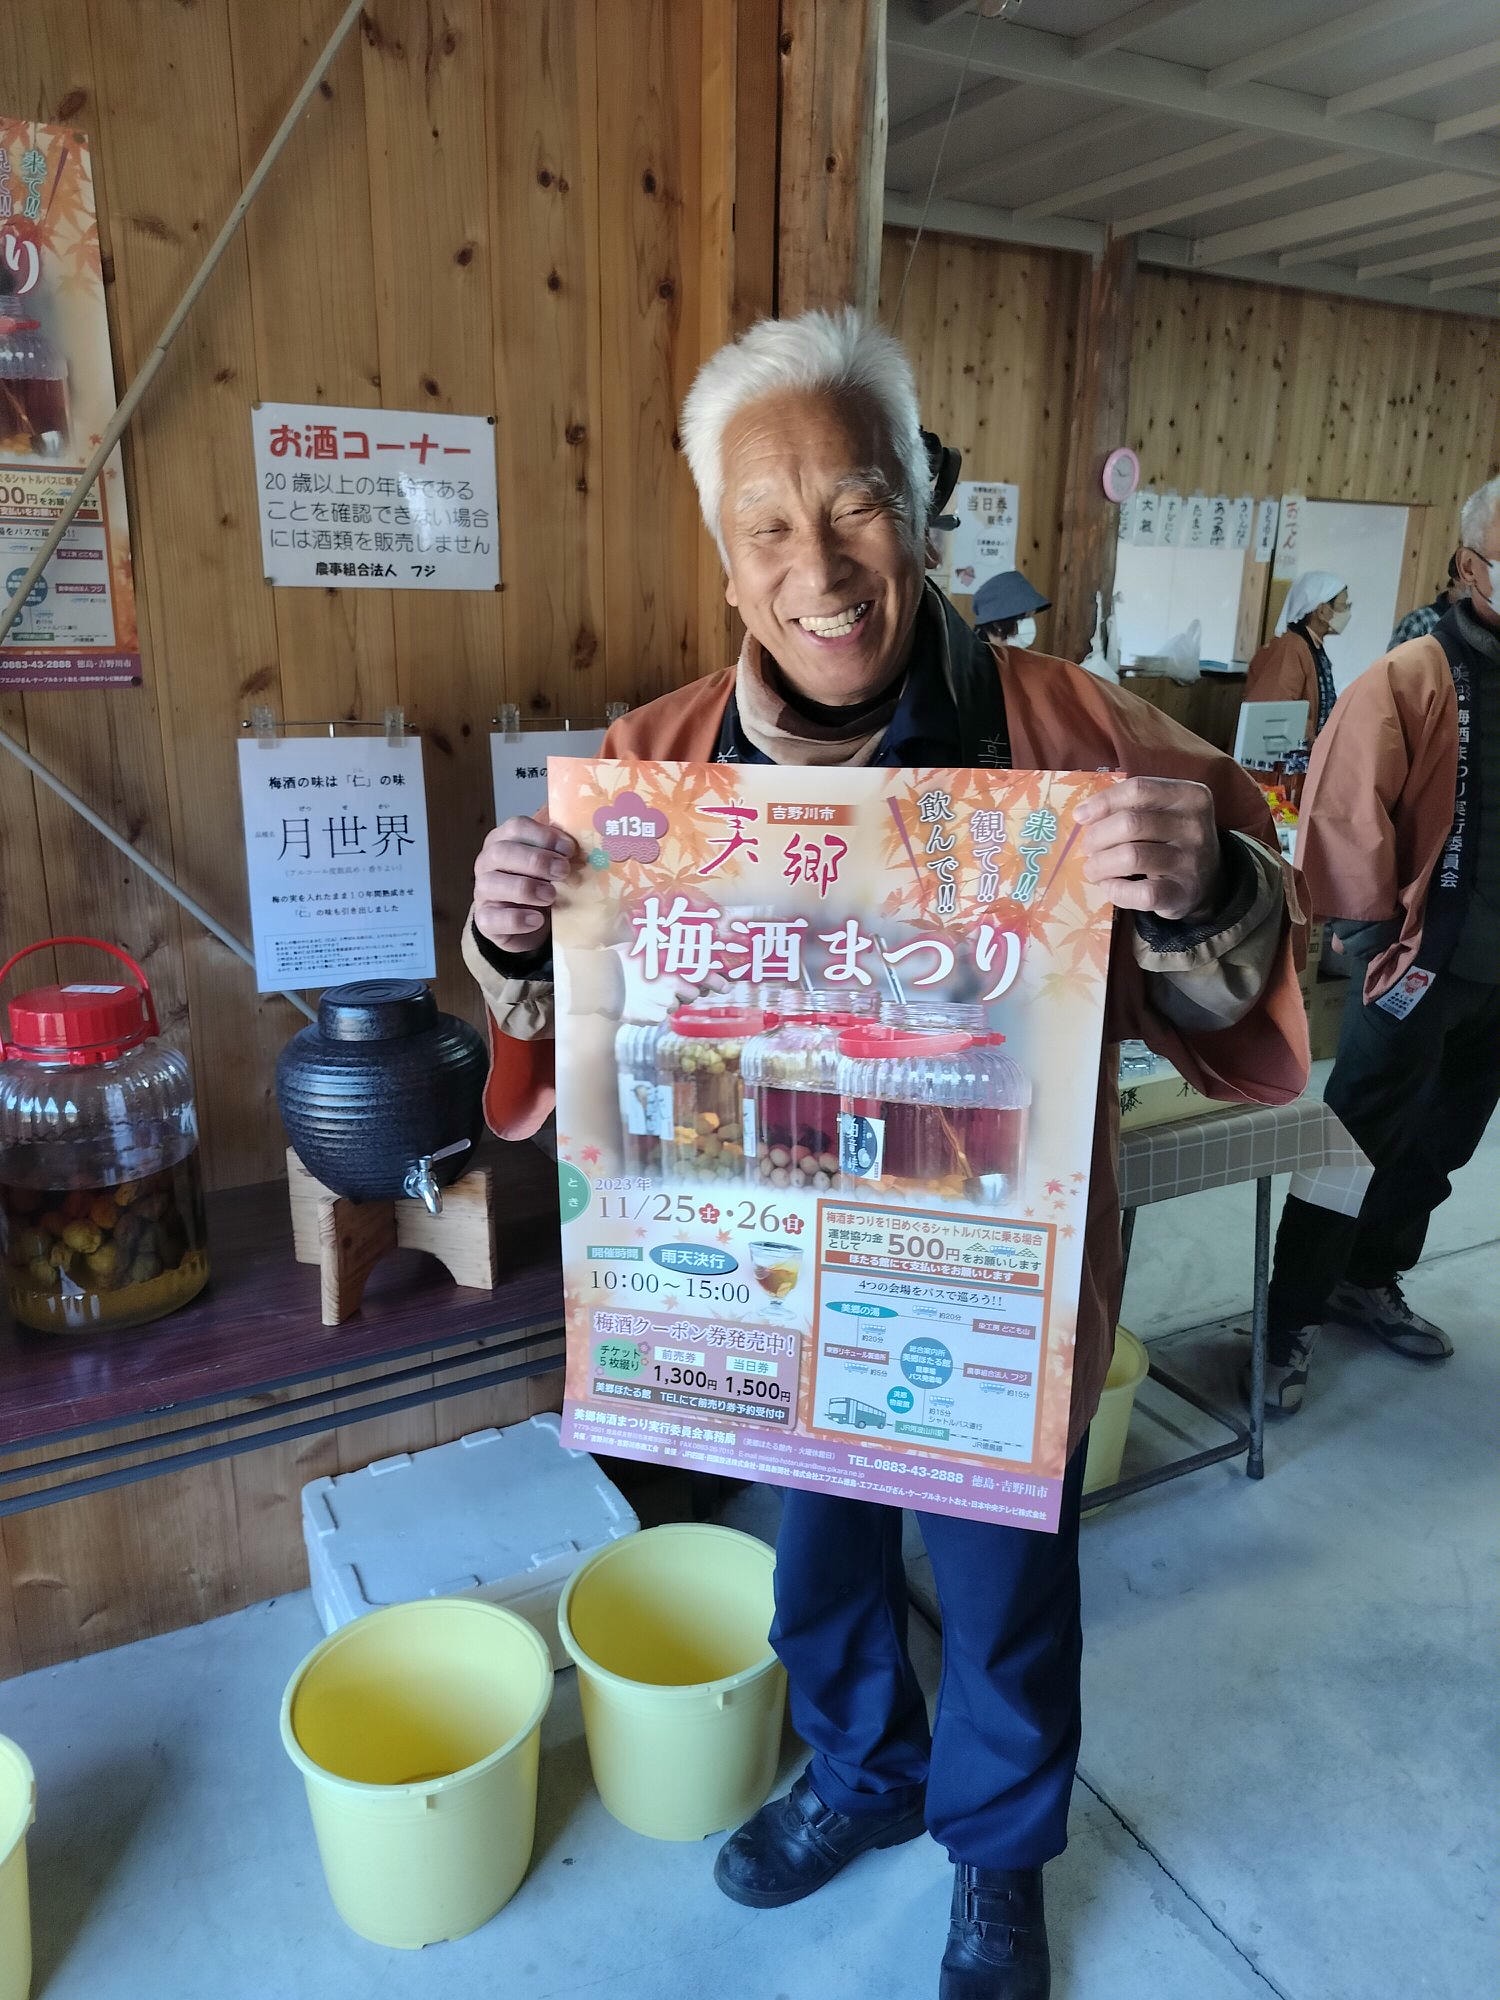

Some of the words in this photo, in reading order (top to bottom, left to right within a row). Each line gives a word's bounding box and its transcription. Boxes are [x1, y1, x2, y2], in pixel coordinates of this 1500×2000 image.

[269, 424, 471, 465] お酒コーナー
[267, 502, 489, 528] ことを確認できない場合
[270, 529, 490, 554] には酒類を販売しません
[315, 562, 397, 577] 農事組合法人
[411, 564, 436, 577] フジ
[269, 773, 406, 789] 梅酒の味は「仁」の味
[772, 806, 836, 820] 吉野川市
[277, 814, 416, 861] 月世界
[605, 815, 656, 837] 第13回
[630, 896, 1022, 1001] 梅酒まつり
[826, 1211, 1043, 1246] 梅酒まつりを1日めぐるシャトルバスに乗る場合
[828, 1228, 883, 1244] 運営協力金
[828, 1239, 861, 1251] として
[591, 1248, 639, 1259] 開催時間
[661, 1249, 726, 1270] 雨天決行
[849, 1253, 1014, 1282] ほたる館にて支払いをお願いします
[962, 1253, 1041, 1271] をお願いします
[601, 1345, 641, 1358] チケット
[662, 1349, 697, 1364] 前売券
[733, 1359, 769, 1374] 当日券
[654, 1365, 718, 1391] 1,300円
[725, 1376, 791, 1403] 1,500円
[1011, 1373, 1027, 1382] フジ
[596, 1382, 652, 1399] 美郷ほたる館
[660, 1391, 786, 1420] TELにて前売り券予約受付中
[574, 1408, 736, 1446] 美郷梅酒まつり実行委員会事務局
[848, 1453, 965, 1484] TEL.0883-43-2888
[971, 1474, 1049, 1499] 徳島・吉野川市
